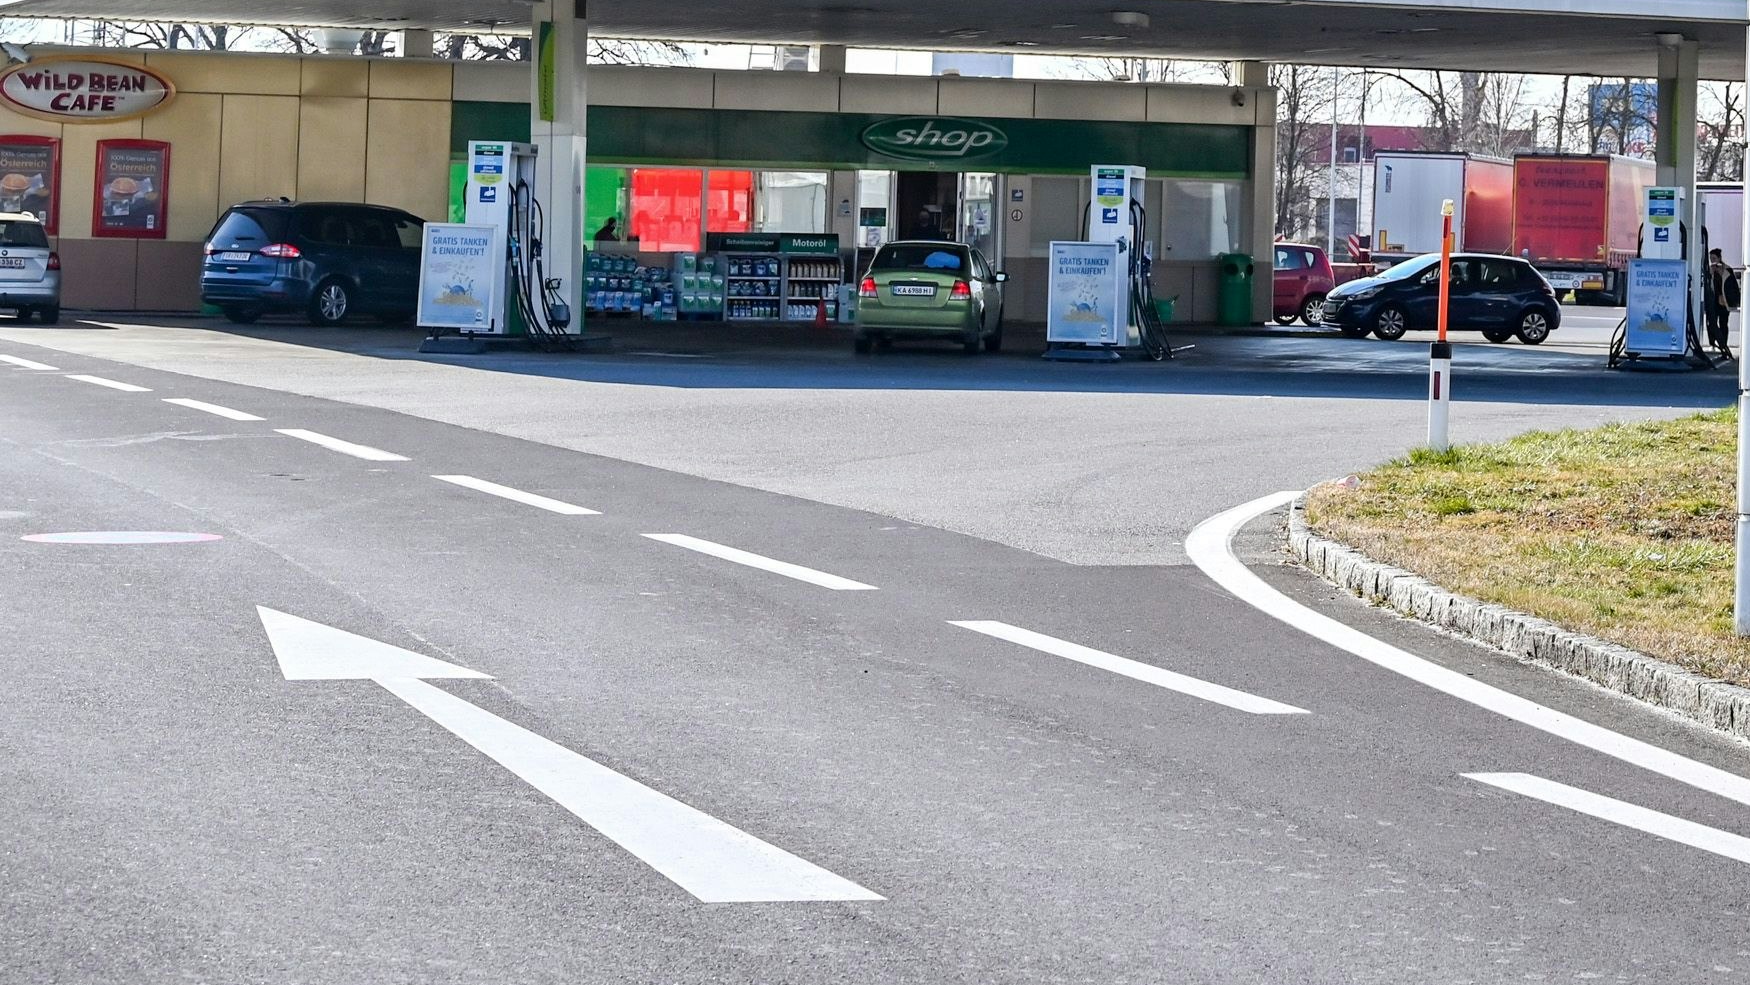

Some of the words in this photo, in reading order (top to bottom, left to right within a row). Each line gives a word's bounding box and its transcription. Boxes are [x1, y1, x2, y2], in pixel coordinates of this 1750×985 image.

[89, 73, 146, 92] BEAN
[895, 121, 993, 156] shop
[433, 237, 458, 246] GRATIS
[460, 238, 488, 247] TANKEN
[792, 239, 826, 247] Motoröl
[1059, 257, 1082, 266] GRATIS
[1084, 258, 1109, 267] TANKEN
